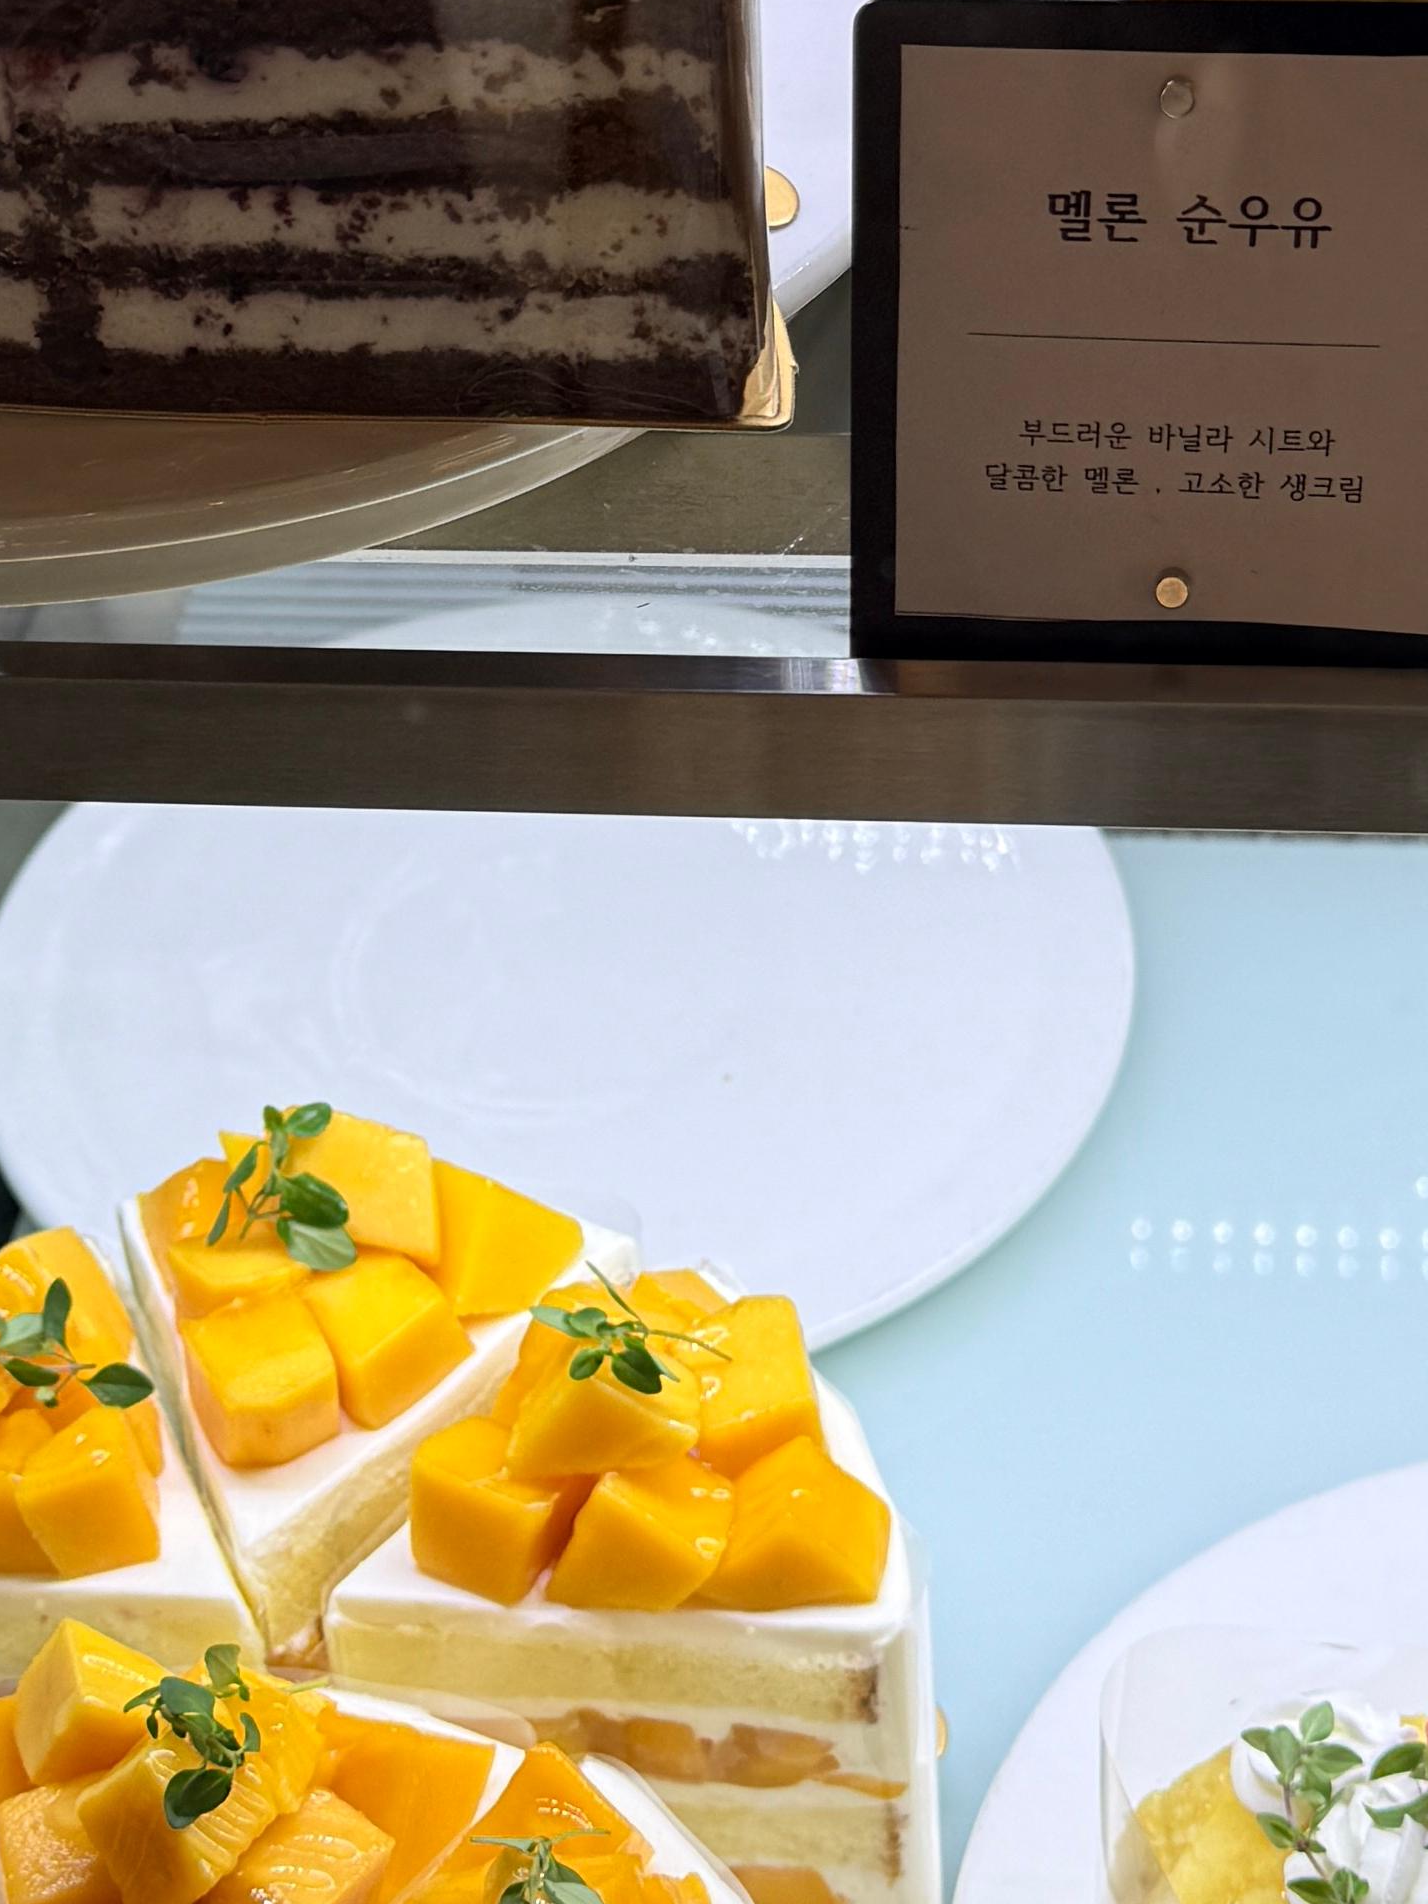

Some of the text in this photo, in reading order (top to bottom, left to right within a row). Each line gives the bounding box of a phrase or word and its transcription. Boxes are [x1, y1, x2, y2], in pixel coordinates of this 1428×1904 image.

[1047, 189, 1333, 250] 멜론 순우유
[1018, 419, 1336, 458] 부드러운 바닐라 시트와
[985, 462, 1069, 493] 달콤한
[1084, 466, 1140, 496] 멜론
[1178, 471, 1266, 500] 고소한
[1279, 473, 1364, 504] 생크림
